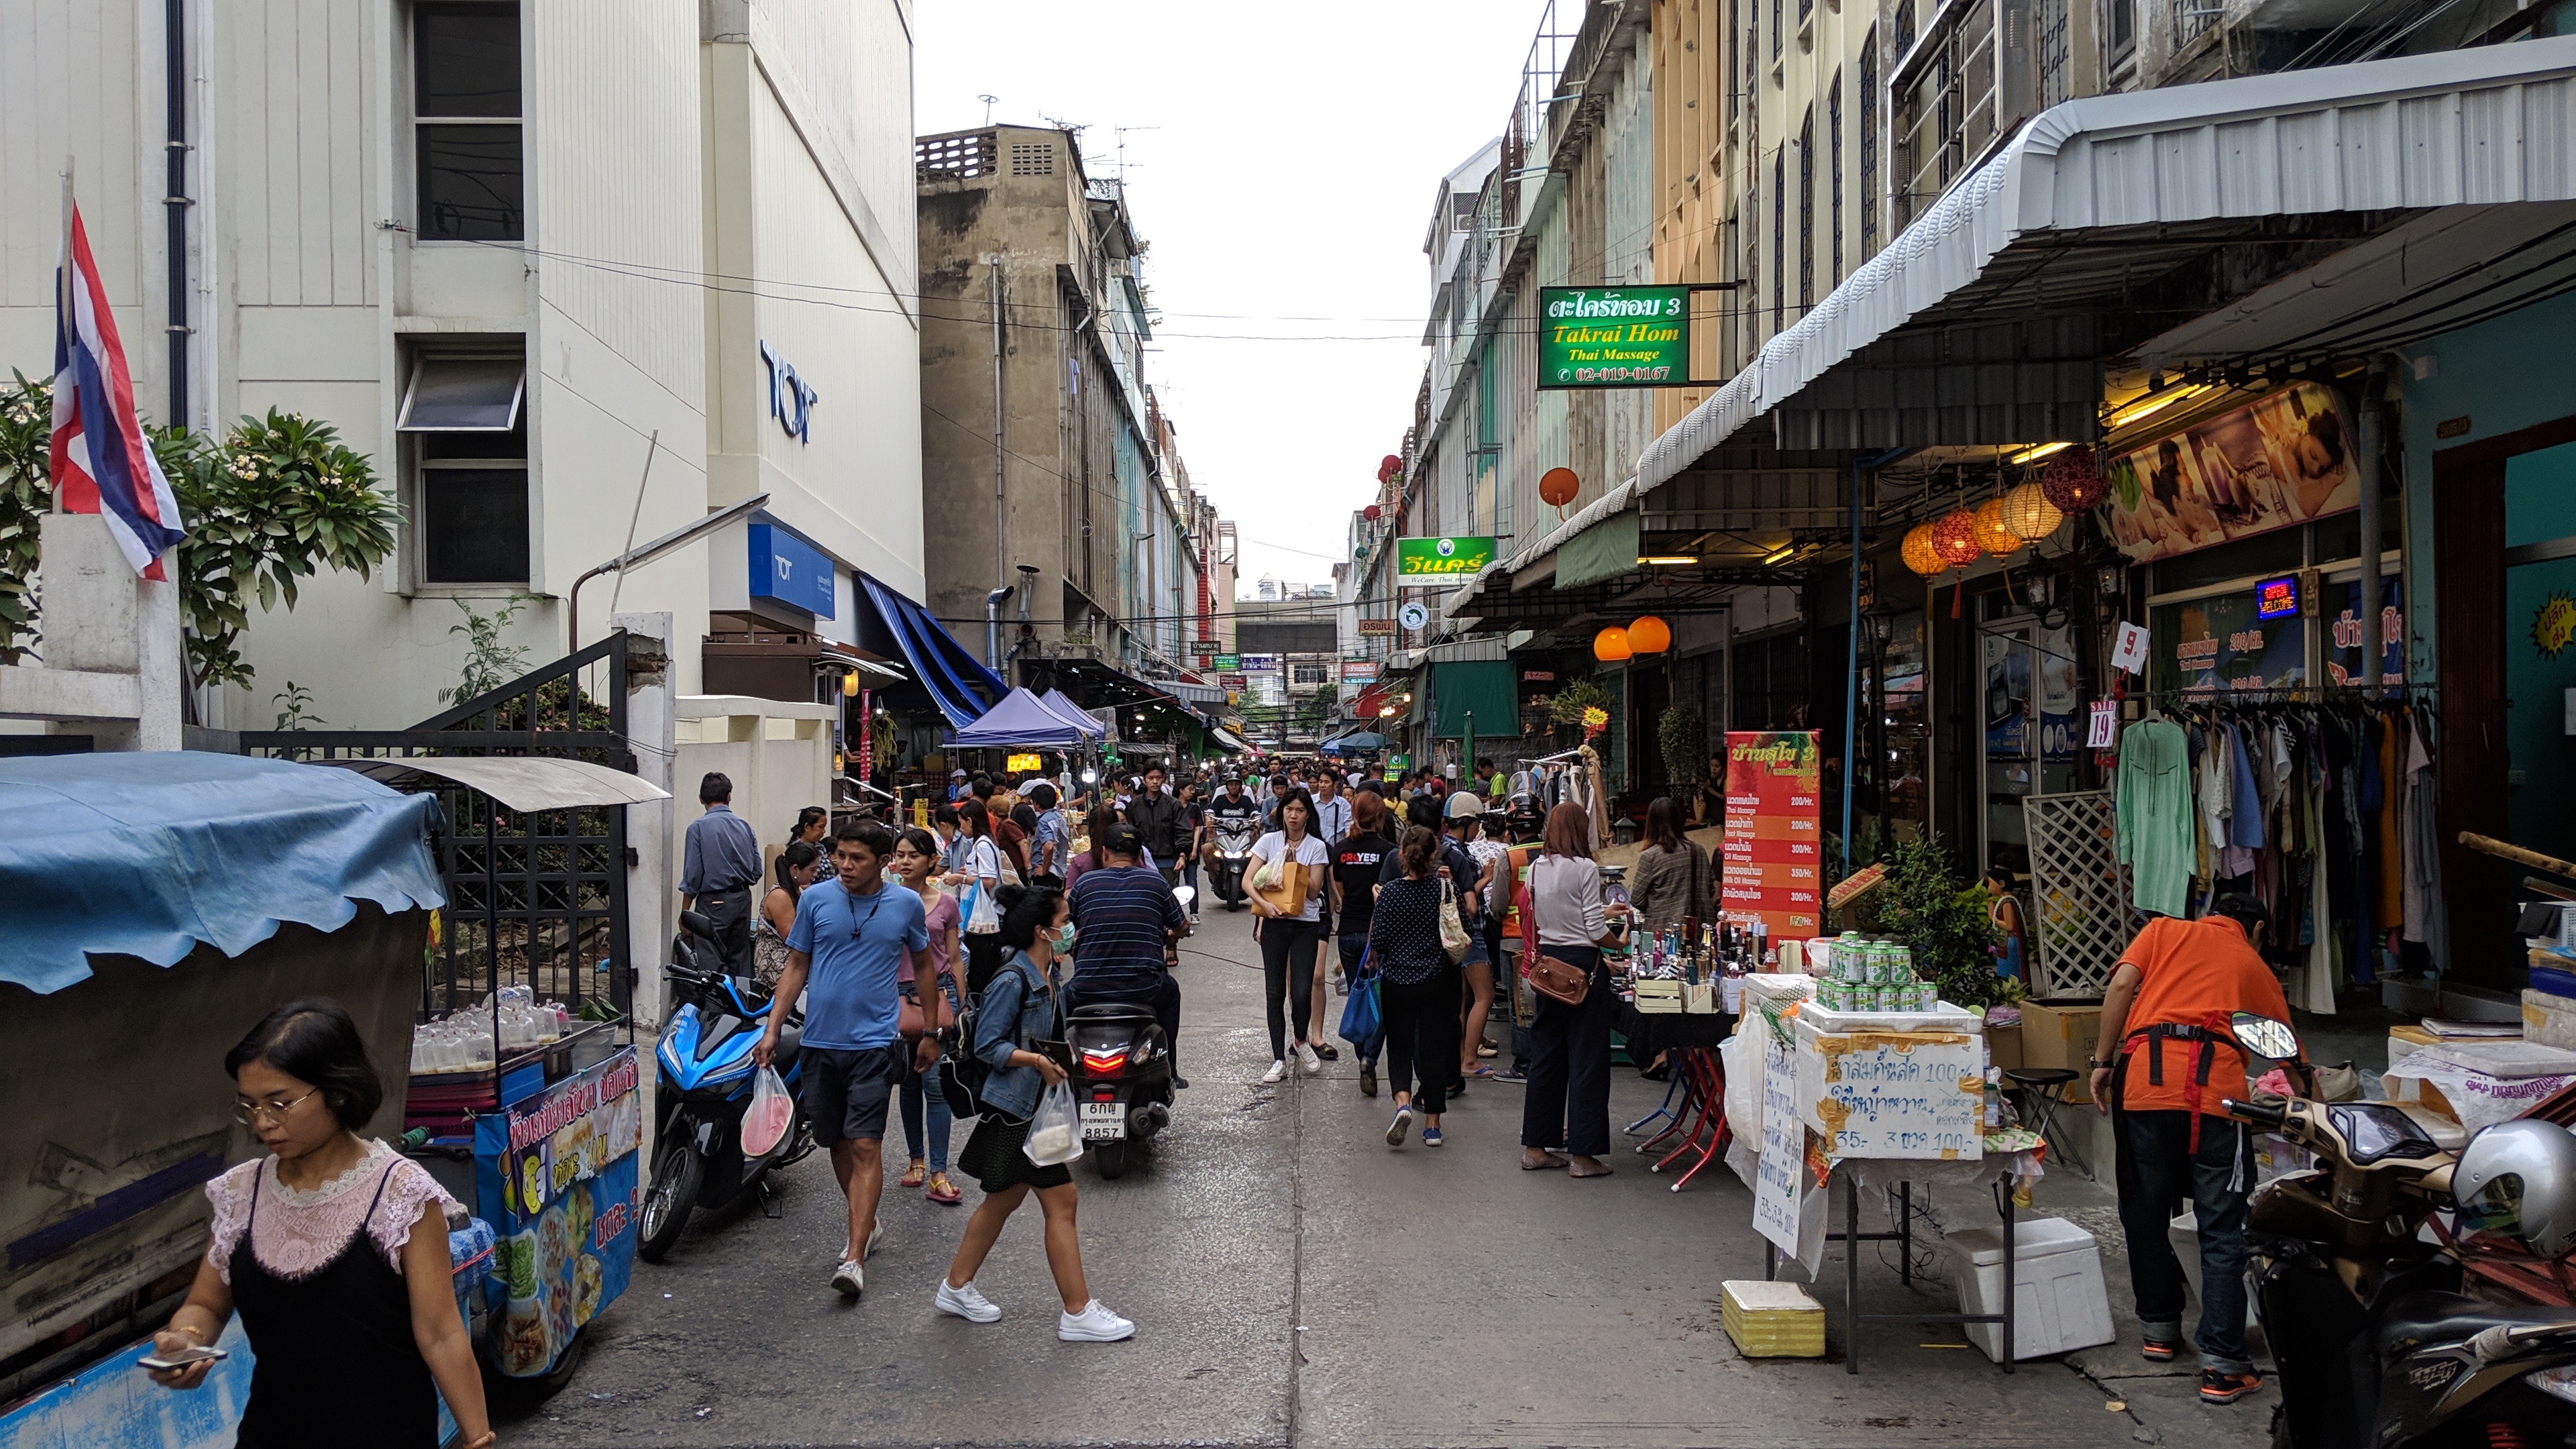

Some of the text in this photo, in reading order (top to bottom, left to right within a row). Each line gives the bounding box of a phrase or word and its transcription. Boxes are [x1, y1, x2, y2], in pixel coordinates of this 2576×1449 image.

[1549, 290, 1681, 317] ตะไคร้หอม 3
[1554, 324, 1679, 343] Takrai Hom
[1569, 349, 1660, 362] Thai Massage
[1576, 366, 1670, 382] 02-019-0167
[760, 339, 818, 445] TOT
[774, 554, 792, 581] TOT
[1405, 551, 1487, 574] วีแคร์
[2265, 584, 2287, 599] OPEN
[2261, 596, 2294, 614] WELCOME
[2091, 702, 2114, 712] SALE
[1588, 712, 1604, 722] 200
[2092, 714, 2109, 745] 19
[1802, 746, 1816, 761] 3
[1791, 796, 1814, 806] 200/Hr.
[1737, 807, 1756, 816] Massage
[1791, 820, 1813, 830] 200/Hr.
[1736, 830, 1756, 839] Massage
[1791, 844, 1813, 854] 300/Hr.
[1732, 853, 1752, 863] Massage
[1791, 867, 1813, 878] 350/Hr.
[1741, 877, 1761, 886] Massage
[1790, 892, 1813, 902] 300/Hr.
[1089, 1104, 1116, 1115] 6กญ
[1081, 1118, 1124, 1126] กรุงเทพมหานคร
[1085, 1128, 1120, 1138] 8857
[1884, 1131, 1897, 1148] 3
[596, 1202, 627, 1256] ชุดละ
